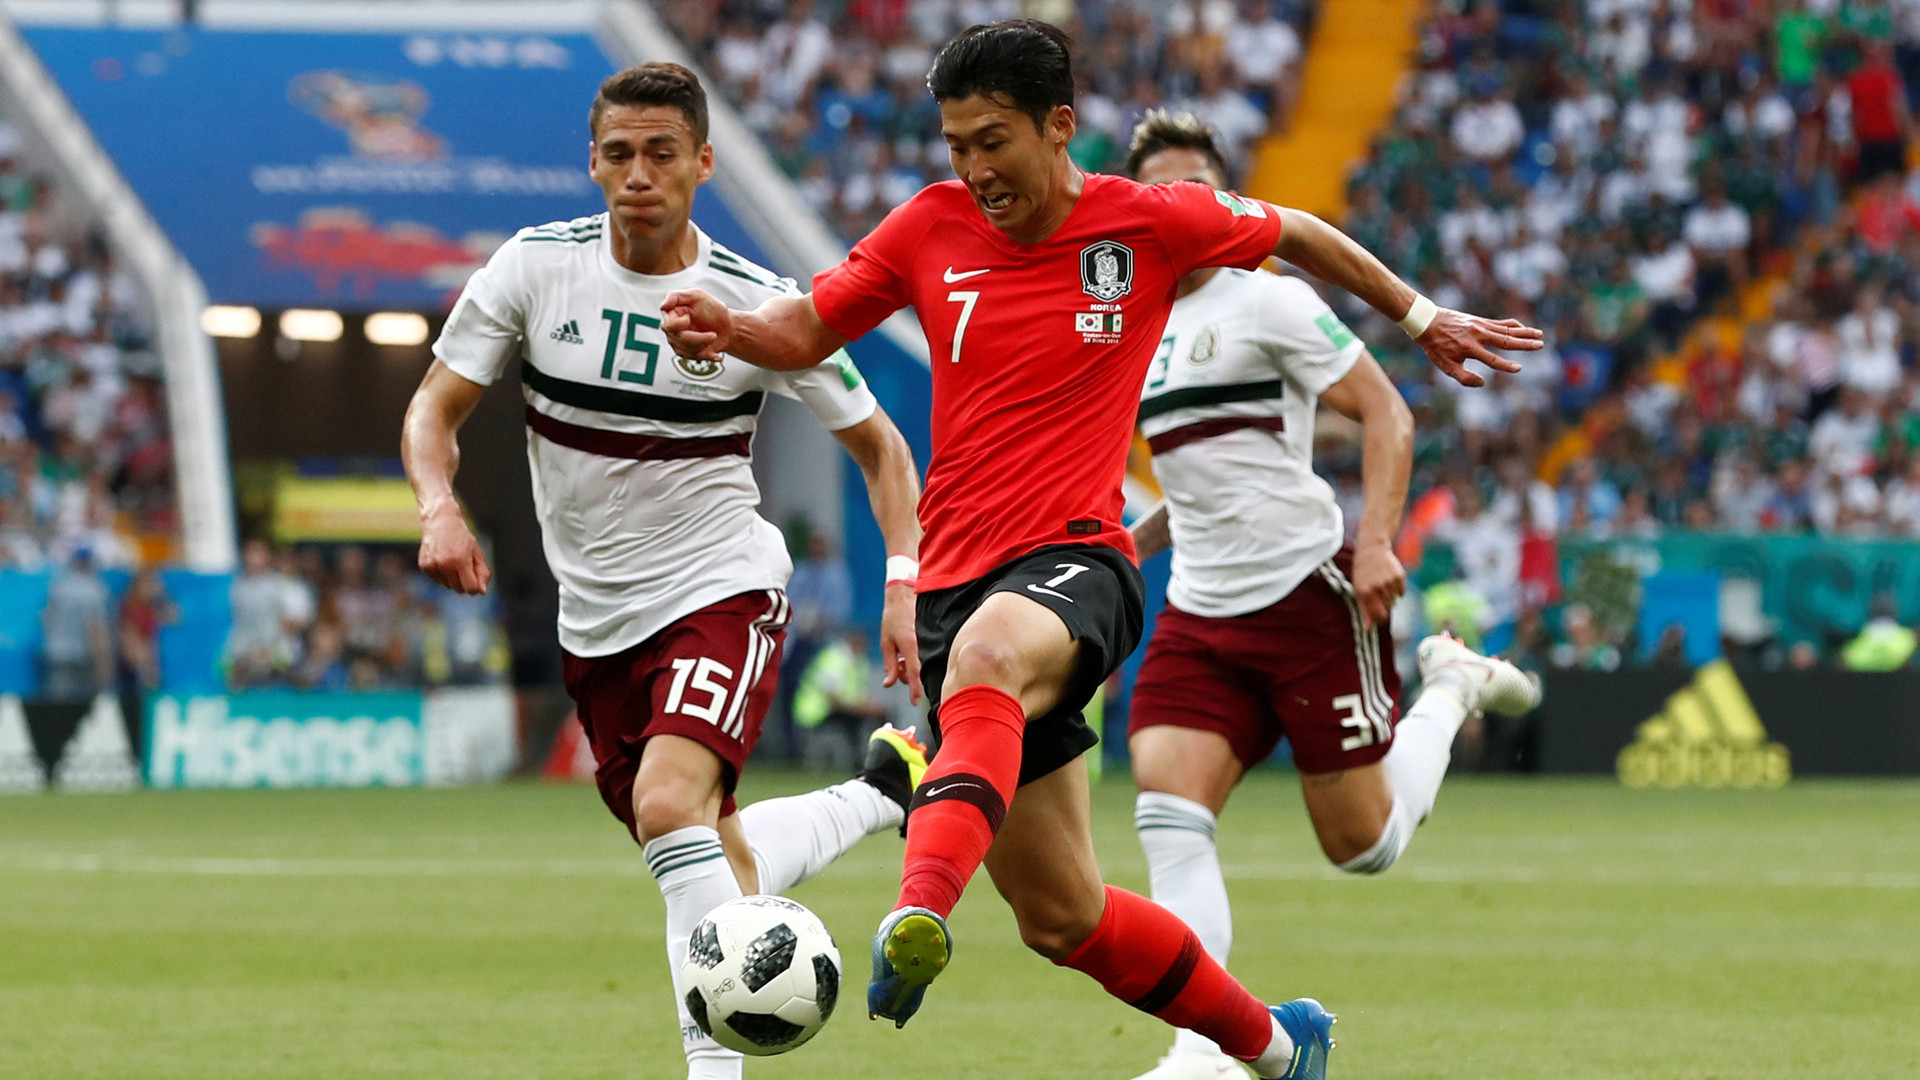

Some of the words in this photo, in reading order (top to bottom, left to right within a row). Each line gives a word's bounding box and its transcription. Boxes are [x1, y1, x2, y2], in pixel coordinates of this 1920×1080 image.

[947, 291, 980, 363] 7
[1090, 304, 1122, 312] KOREA
[550, 331, 584, 345] adidas
[601, 308, 661, 386] 15
[1044, 563, 1090, 588] 7
[663, 656, 734, 726] 15
[147, 696, 420, 788] Hisense
[1332, 693, 1373, 752] 3
[1616, 741, 1793, 789] adidas
